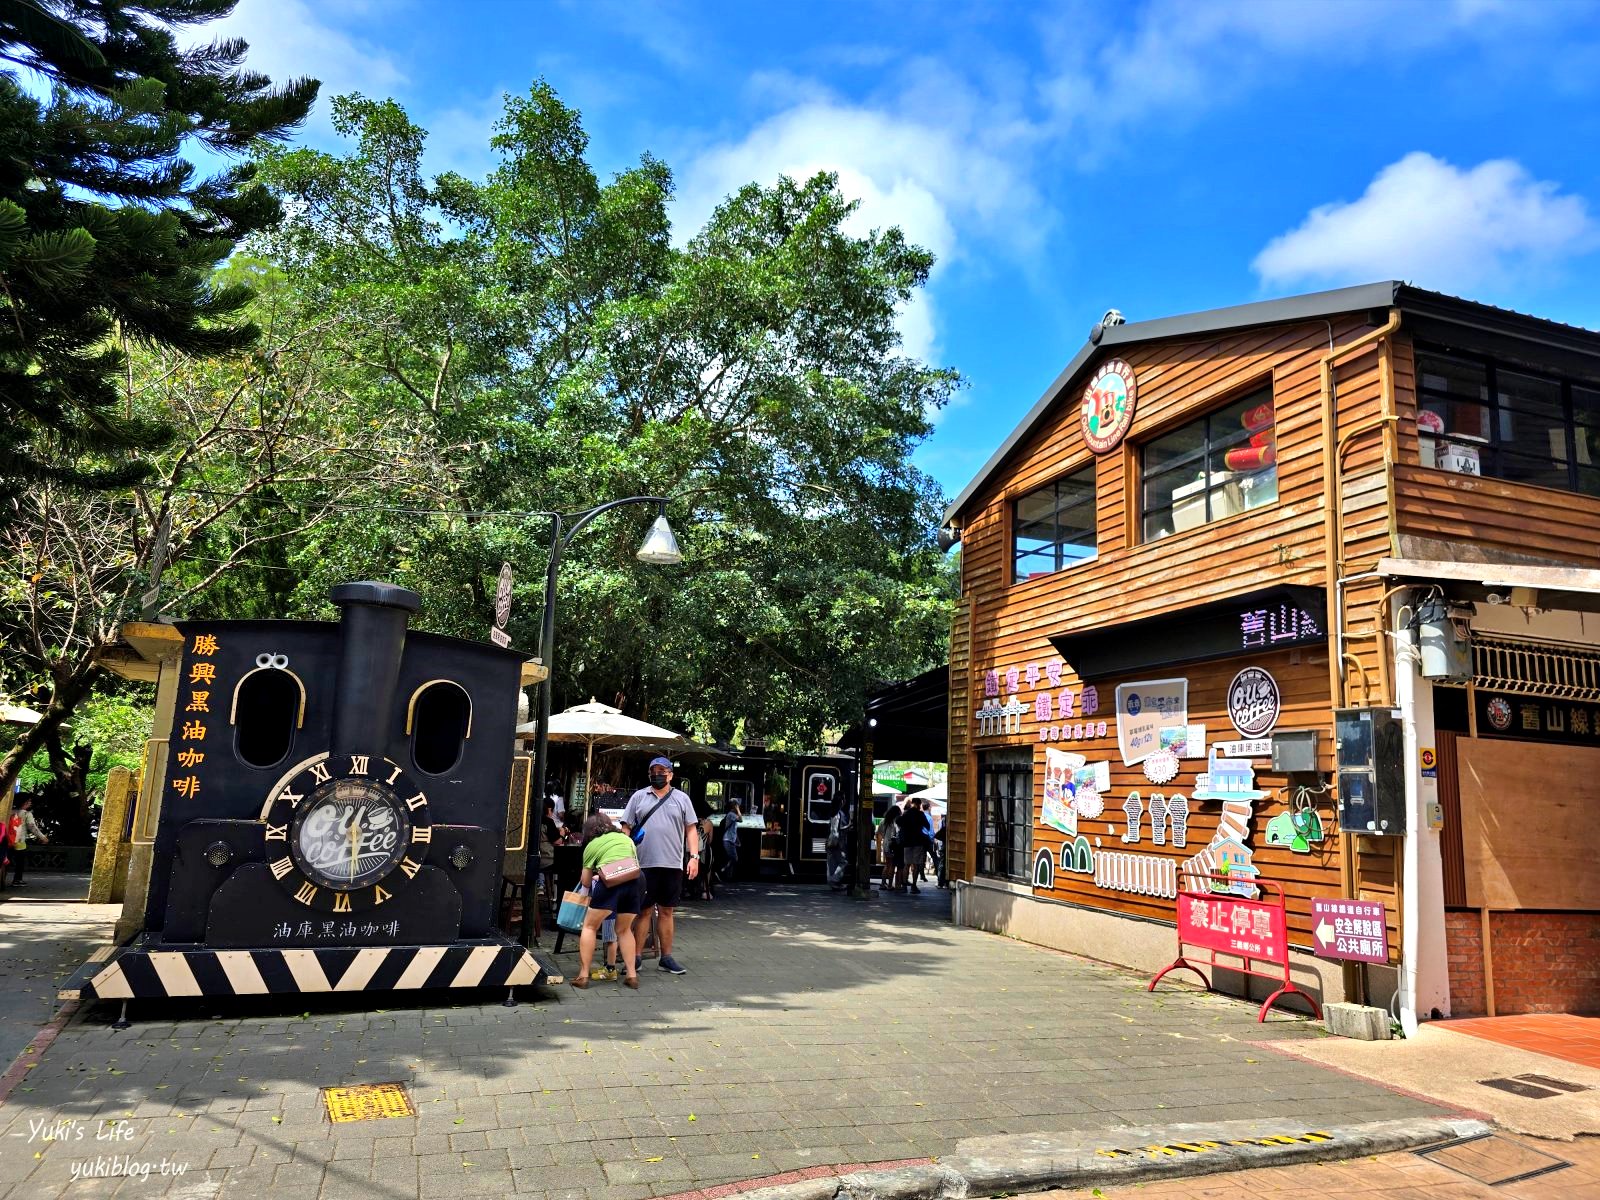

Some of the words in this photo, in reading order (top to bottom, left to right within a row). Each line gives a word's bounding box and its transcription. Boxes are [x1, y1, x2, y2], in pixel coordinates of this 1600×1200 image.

[173, 633, 221, 799] 勝興黑油咖啡
[308, 762, 332, 785] XI
[349, 755, 369, 775] XII
[385, 766, 403, 785] I
[278, 785, 304, 808] X
[406, 792, 428, 811] II
[265, 823, 288, 842] IX
[411, 825, 432, 844] III
[270, 856, 294, 881] VIII
[400, 856, 421, 879] IV
[294, 880, 318, 906] VII
[332, 892, 352, 913] VI
[374, 884, 392, 905] V
[273, 919, 401, 939] 油庫黑油咖啡
[1190, 898, 1273, 940] 禁止停車
[1334, 917, 1383, 937] 安全解說區
[1336, 937, 1384, 957] 公共廁所
